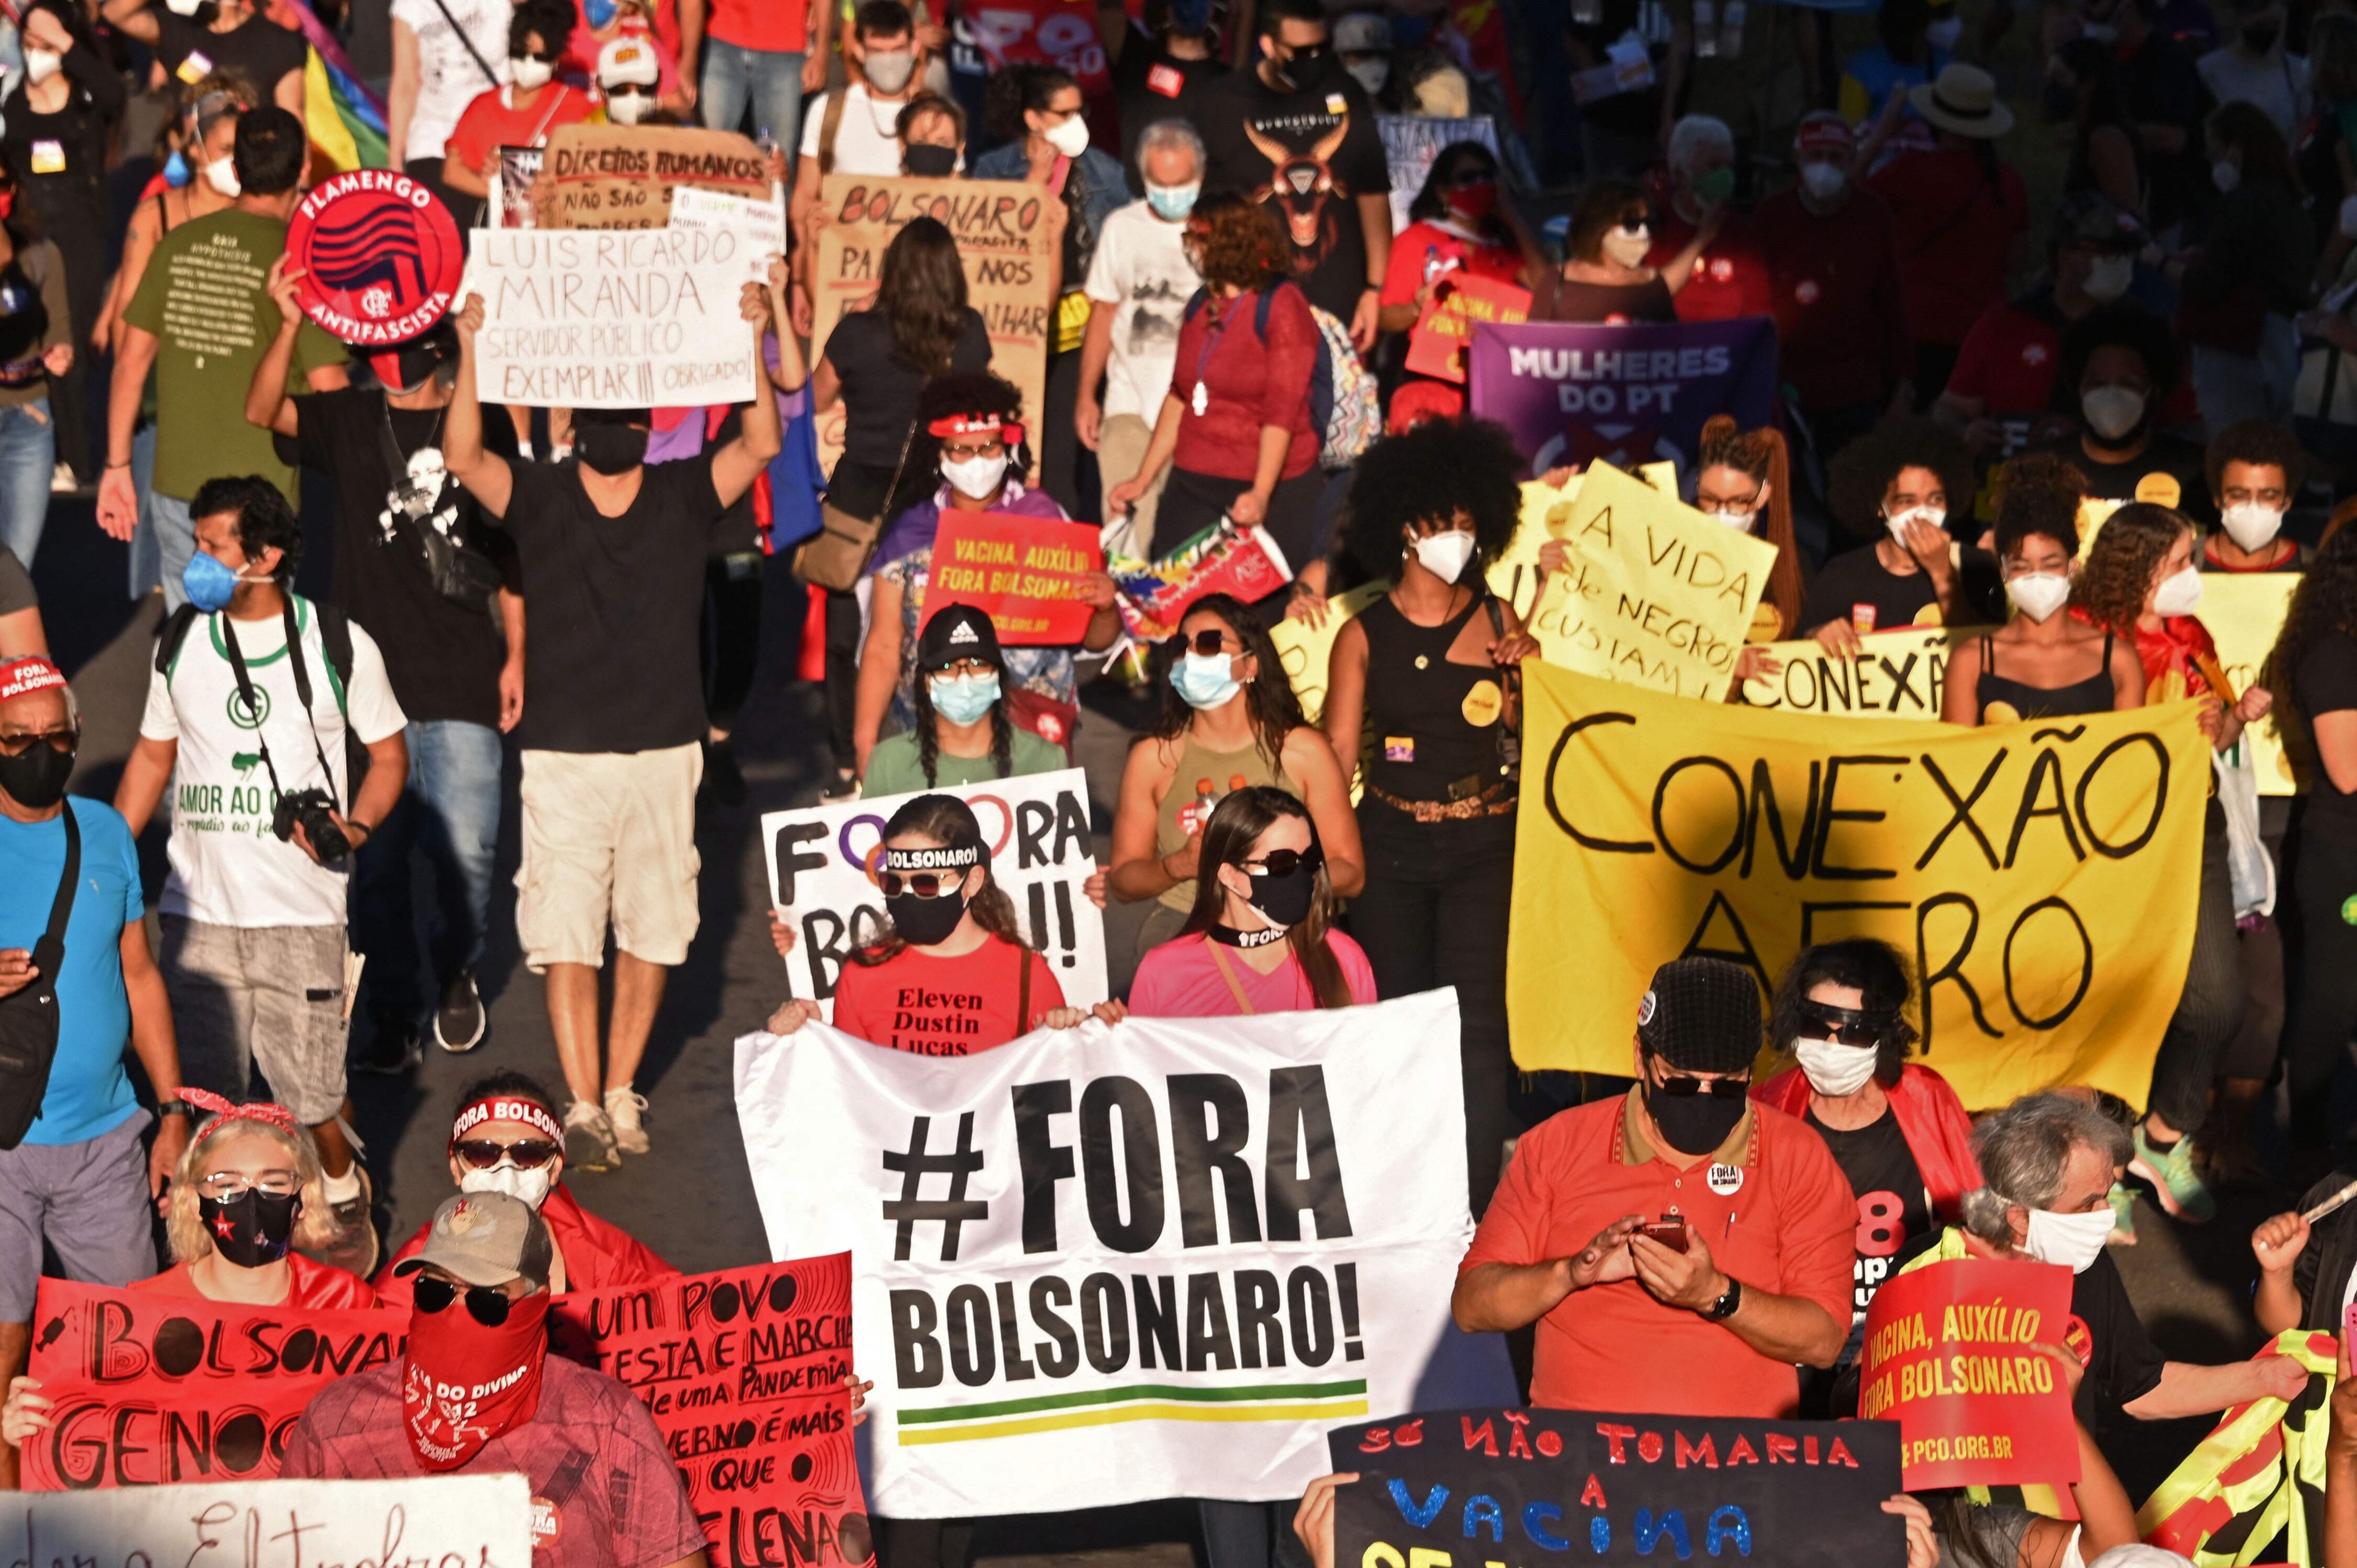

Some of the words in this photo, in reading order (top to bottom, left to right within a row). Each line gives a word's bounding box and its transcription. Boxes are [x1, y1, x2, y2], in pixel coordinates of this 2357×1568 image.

[555, 141, 649, 176] DIREITOS
[655, 149, 765, 180] HUMANOS
[300, 170, 431, 220] FLAMENGO
[564, 183, 601, 209] NÃO
[610, 181, 647, 207] SÃO
[838, 186, 1041, 236] BOLSONARO
[486, 235, 580, 269] LUIS
[598, 229, 736, 269] RICARDO
[977, 260, 1033, 284] NOS
[497, 271, 706, 320] MIRANDA
[310, 292, 450, 341] ANTIFASCISTA
[487, 322, 583, 359] SERVIDOR
[592, 321, 683, 357] PÚBLICO
[1509, 346, 1731, 381] MULHERES
[1559, 384, 1616, 414] DO
[1627, 384, 1679, 414] PT
[955, 538, 1018, 566] VACINA,
[1025, 543, 1089, 571] AUXÍLIO
[1581, 505, 1612, 548] A
[1646, 525, 1749, 614] VIDA
[939, 567, 985, 593] FORA
[990, 574, 1080, 601] BOLSONA
[1562, 565, 1601, 603] de
[14, 663, 50, 682] FORA
[1743, 636, 1946, 713] ONEXÃ
[179, 783, 223, 814] AMOR
[231, 787, 261, 815] AO
[1545, 712, 2169, 879] CONEXÃO
[897, 988, 983, 1010] Eleven
[894, 1011, 979, 1034] Dustin
[891, 1035, 968, 1056] Lucas
[458, 1103, 489, 1138] FORA
[882, 1064, 1353, 1261] #FORA
[1712, 1166, 1736, 1177] FORA
[684, 1274, 797, 1331] POVO
[889, 1262, 1364, 1389] BOLSONARO!
[1869, 1312, 1933, 1372] VACINA,
[1942, 1296, 2041, 1344] AUXÍLIO
[715, 1330, 737, 1367] E
[436, 1382, 466, 1401] DO
[1864, 1373, 1895, 1420] FORA
[1901, 1354, 2054, 1403] BOLSONARO
[1359, 1418, 1424, 1452] SÓ
[1461, 1409, 1563, 1460] NÃO
[1596, 1421, 1859, 1468] TOMARIA
[1912, 1435, 2013, 1464] PCO.ORG.BR
[712, 1456, 775, 1492] QUE
[1580, 1472, 1607, 1509] A
[1386, 1477, 1752, 1560] VACINA
